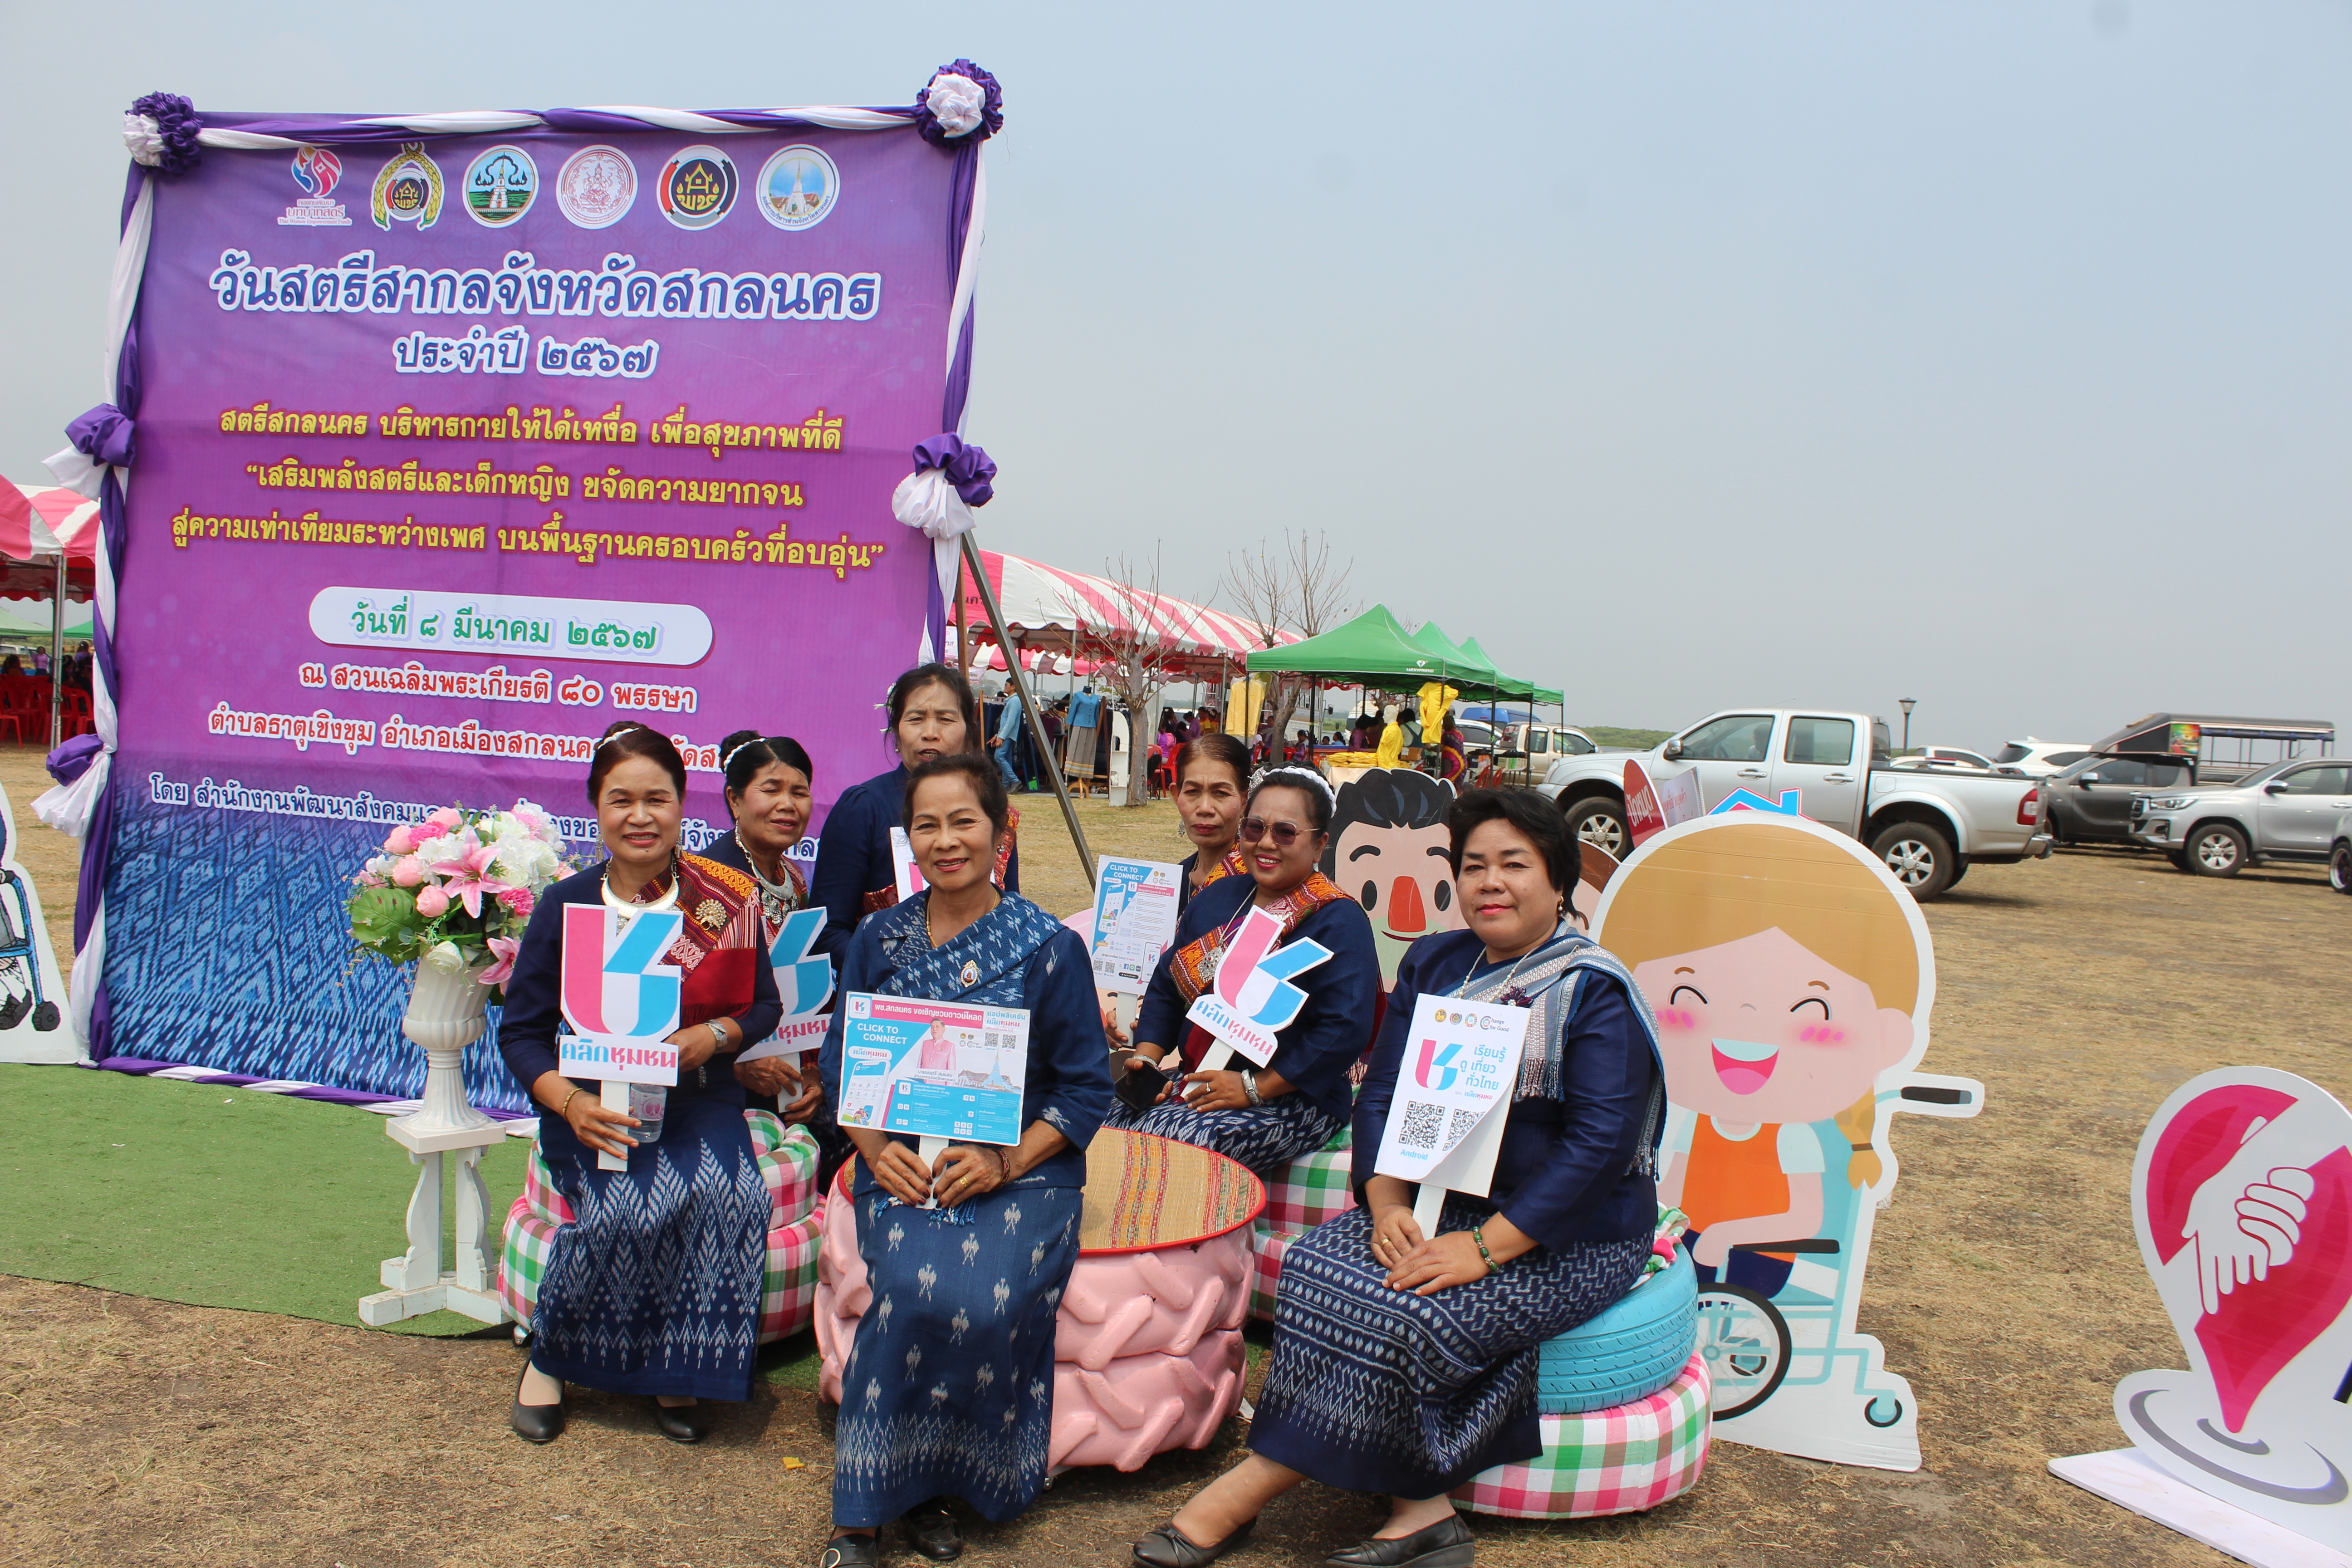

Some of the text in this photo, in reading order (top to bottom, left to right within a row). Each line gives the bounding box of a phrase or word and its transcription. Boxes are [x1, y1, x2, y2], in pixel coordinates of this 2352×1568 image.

[288, 206, 344, 217] บทบาทสตรี
[212, 252, 878, 317] วันสตรีสากลจังหวัดสกลนคร
[396, 328, 654, 372] ประจำปี ๒๕๖๗
[220, 402, 843, 457] สตรีสกลนคร บริหารกายให้ได้เหงื่อ เพื่อสุขภาพที่ดี
[246, 457, 803, 506] “เสริมพลังสตรีและเด็กหญิง ขจัดความยากจน
[172, 508, 884, 578] สู่ความเท่าเทียมระหว่างเพศ บนพื้นฐานครอบครัวที่อบอุ่น”
[351, 596, 657, 650] วันที่ ๘ มีนาคม ๒๕๖๗
[302, 663, 694, 710] ณ สวนเฉลิมพระเกียรติ ๘๐ พรรษา
[211, 704, 373, 751] ตำบลธาตุเชิงชุม
[384, 716, 598, 759] อำเภอเมืองสกลนค
[151, 774, 186, 803] โดย
[1113, 871, 1144, 881] CONNECT
[874, 1003, 983, 1021] พช.สกลนคร ขอเชิญชวนดาวน์โหลด
[987, 1011, 1026, 1020] แอปพลิเคชัน
[857, 1023, 899, 1034] CLICK TO
[863, 1033, 908, 1045] CONNECT
[1474, 1044, 1507, 1063] เรียนรู้
[1460, 1056, 1497, 1074] ดู เที่ยว
[1465, 1071, 1499, 1091] ทั่วไทย
[1400, 1149, 1429, 1161] Android
